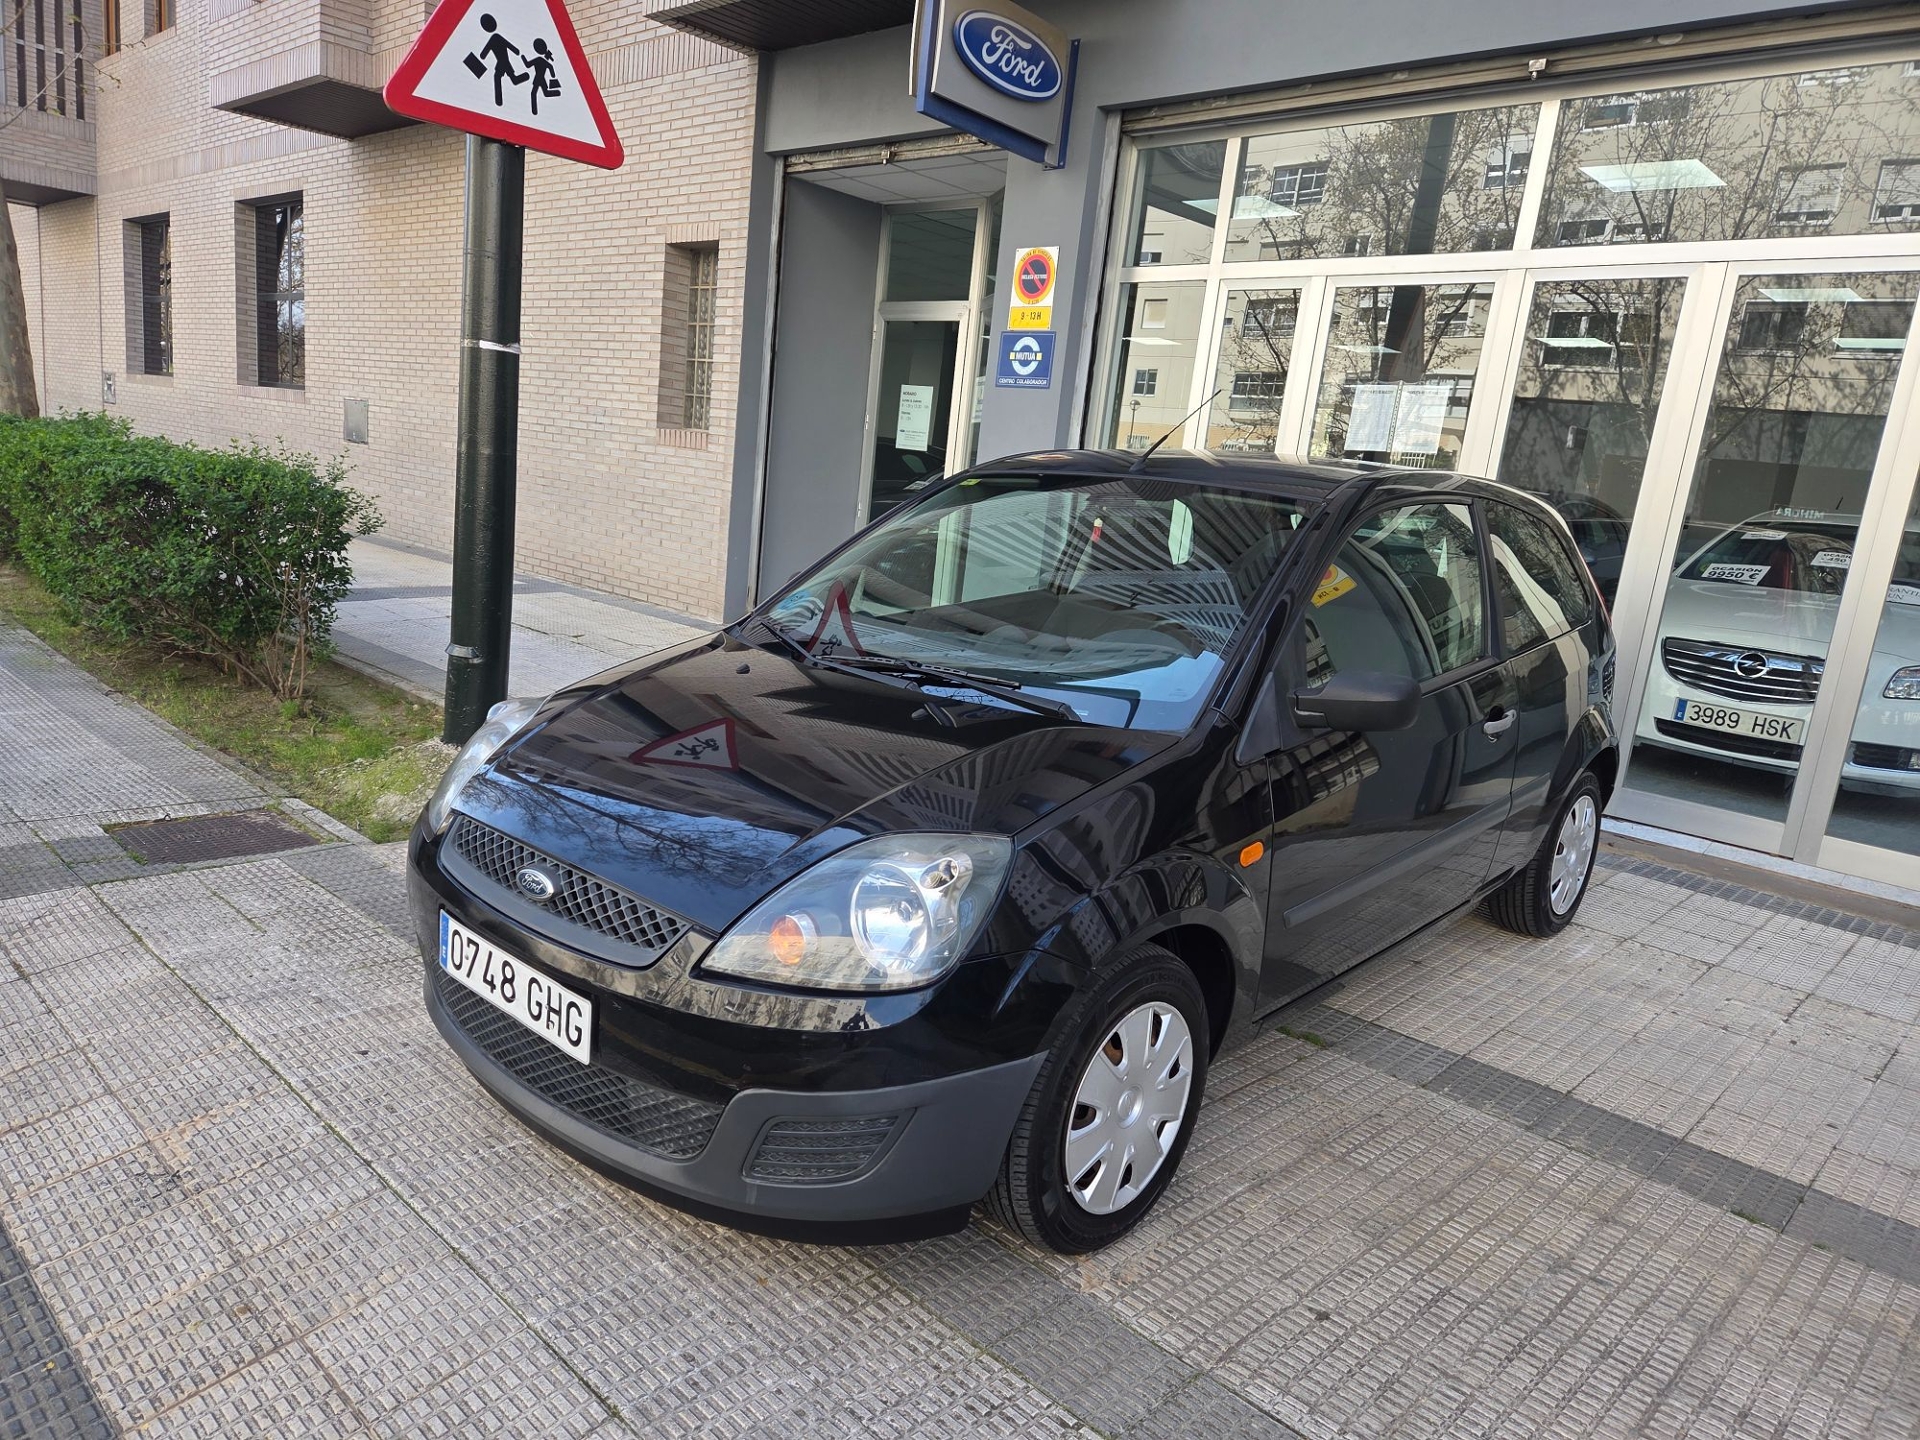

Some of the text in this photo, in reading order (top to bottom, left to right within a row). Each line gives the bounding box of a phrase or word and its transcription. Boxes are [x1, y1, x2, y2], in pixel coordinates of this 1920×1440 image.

[981, 25, 1044, 87] Ford
[1016, 352, 1036, 360] MUTUA
[1707, 571, 1760, 580] 9950 €
[1688, 704, 1740, 730] 3989
[1751, 716, 1797, 740] HSK
[522, 873, 546, 894] Ford
[450, 929, 517, 1004] 0748
[526, 977, 584, 1048] GHG
